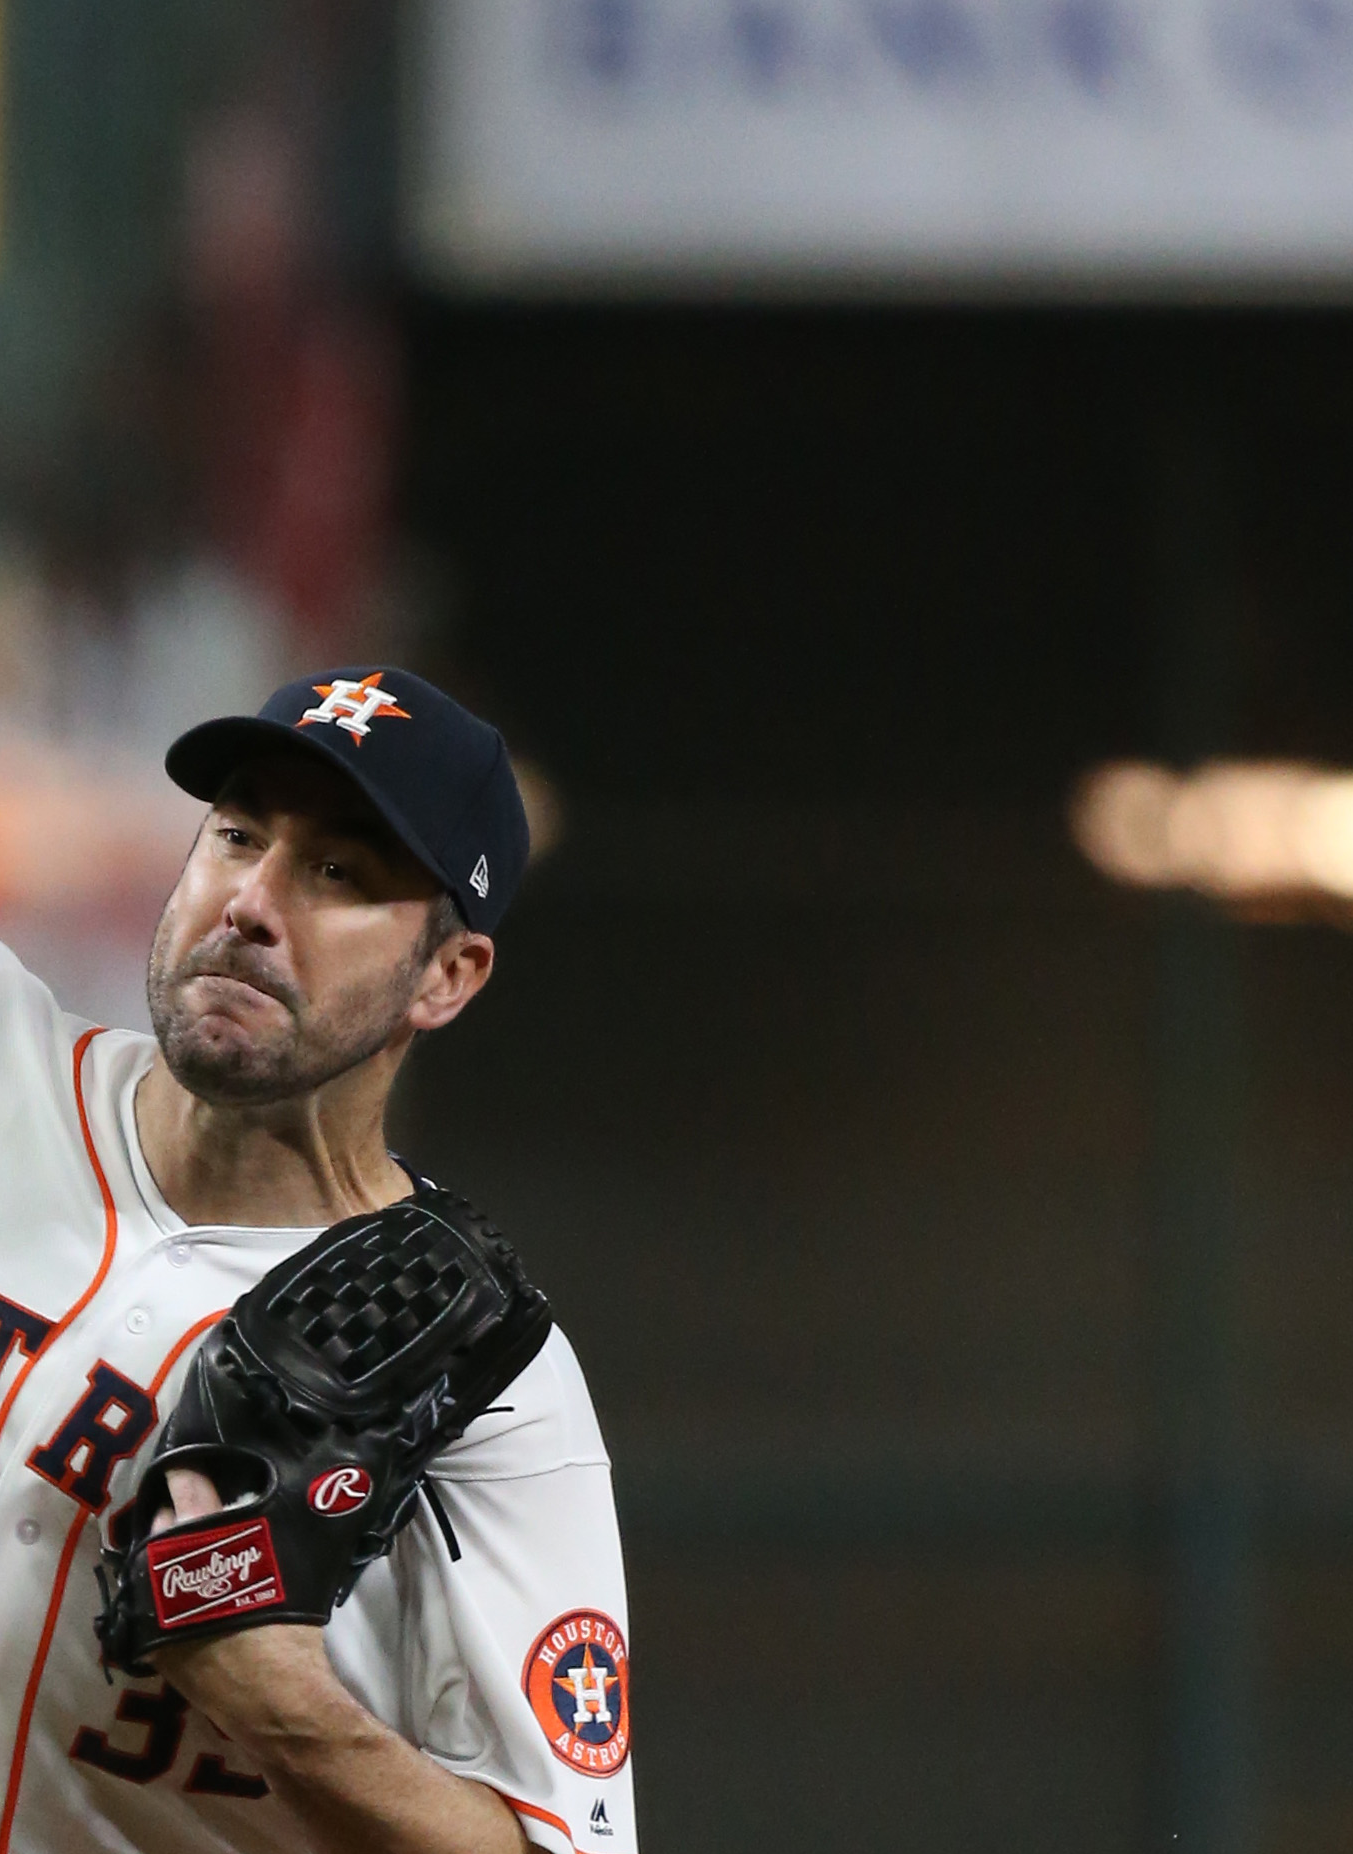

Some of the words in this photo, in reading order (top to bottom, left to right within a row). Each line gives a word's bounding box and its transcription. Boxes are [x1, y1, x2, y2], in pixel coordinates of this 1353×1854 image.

[302, 678, 398, 738] H
[314, 1467, 367, 1512] R
[162, 1546, 262, 1598] Rawlings
[539, 1619, 624, 1667] HOUSTON
[567, 1666, 612, 1723] H
[555, 1730, 627, 1766] ASTROS
